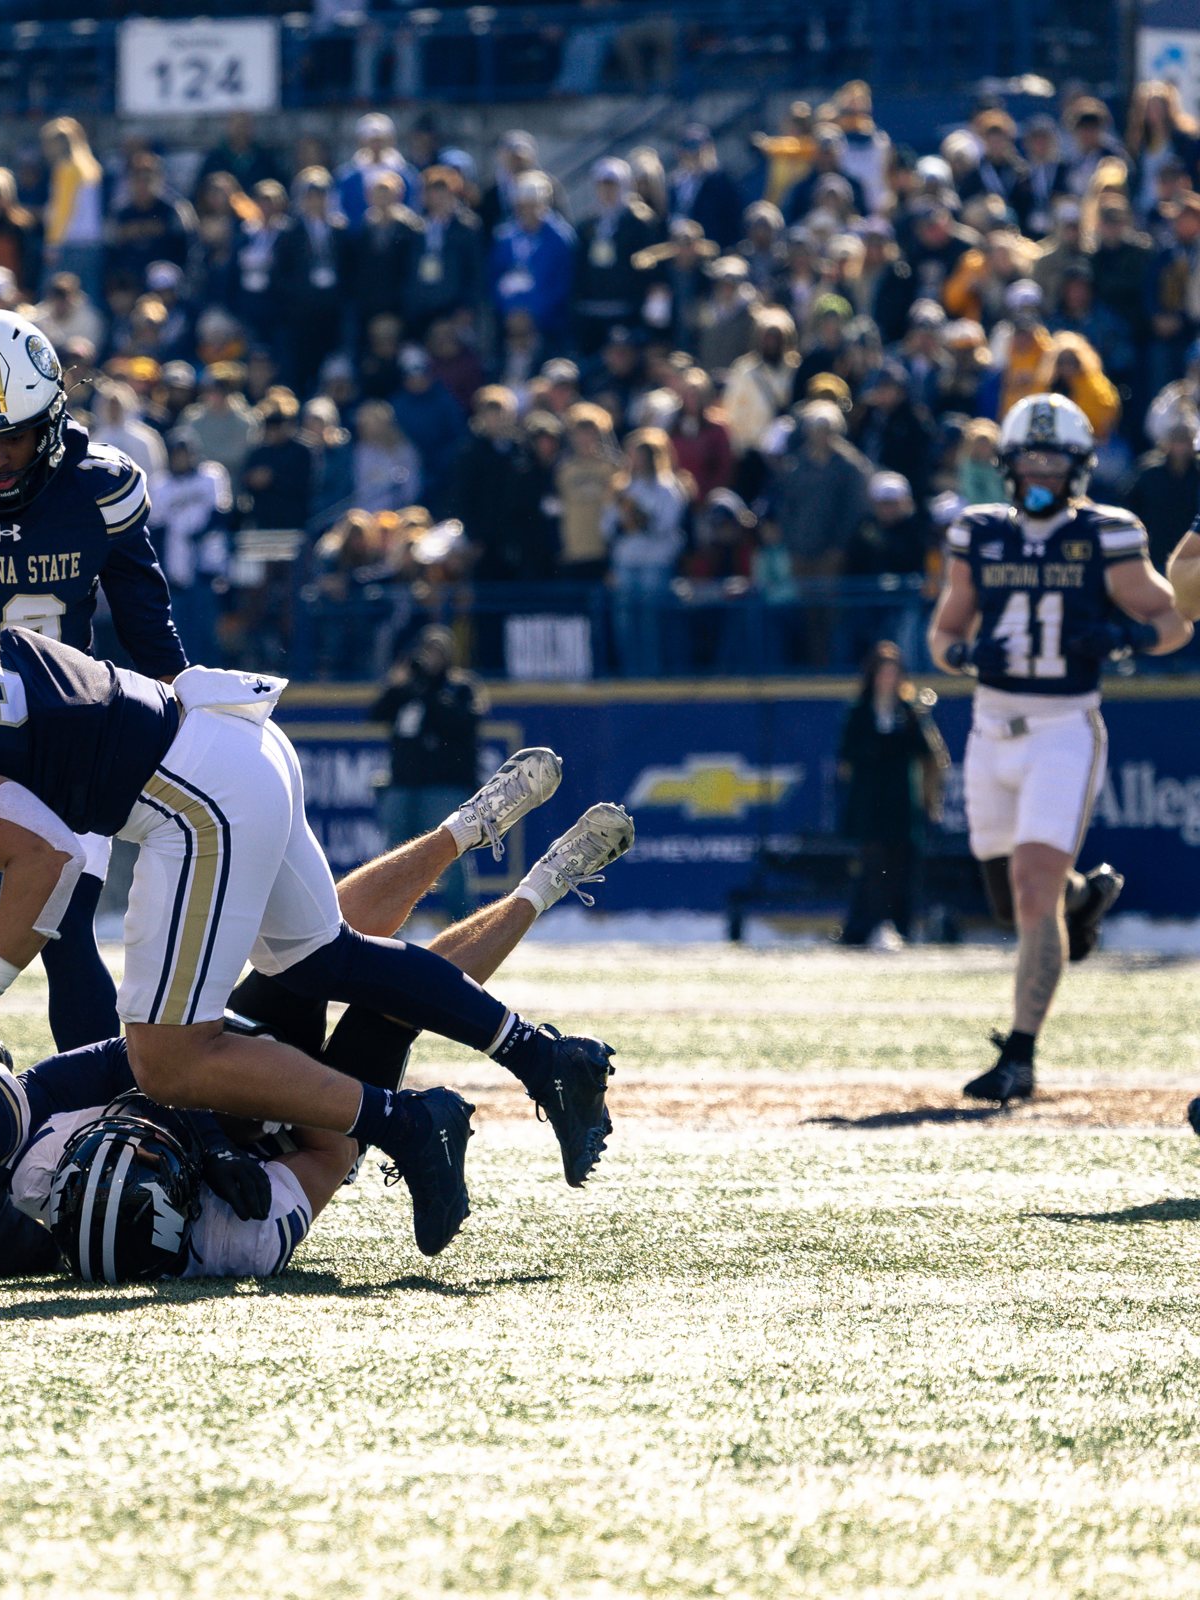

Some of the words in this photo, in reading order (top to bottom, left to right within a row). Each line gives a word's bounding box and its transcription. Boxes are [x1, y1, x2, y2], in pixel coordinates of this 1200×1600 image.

[153, 56, 243, 100] 124
[27, 552, 81, 584] STATE
[991, 591, 1067, 678] 41
